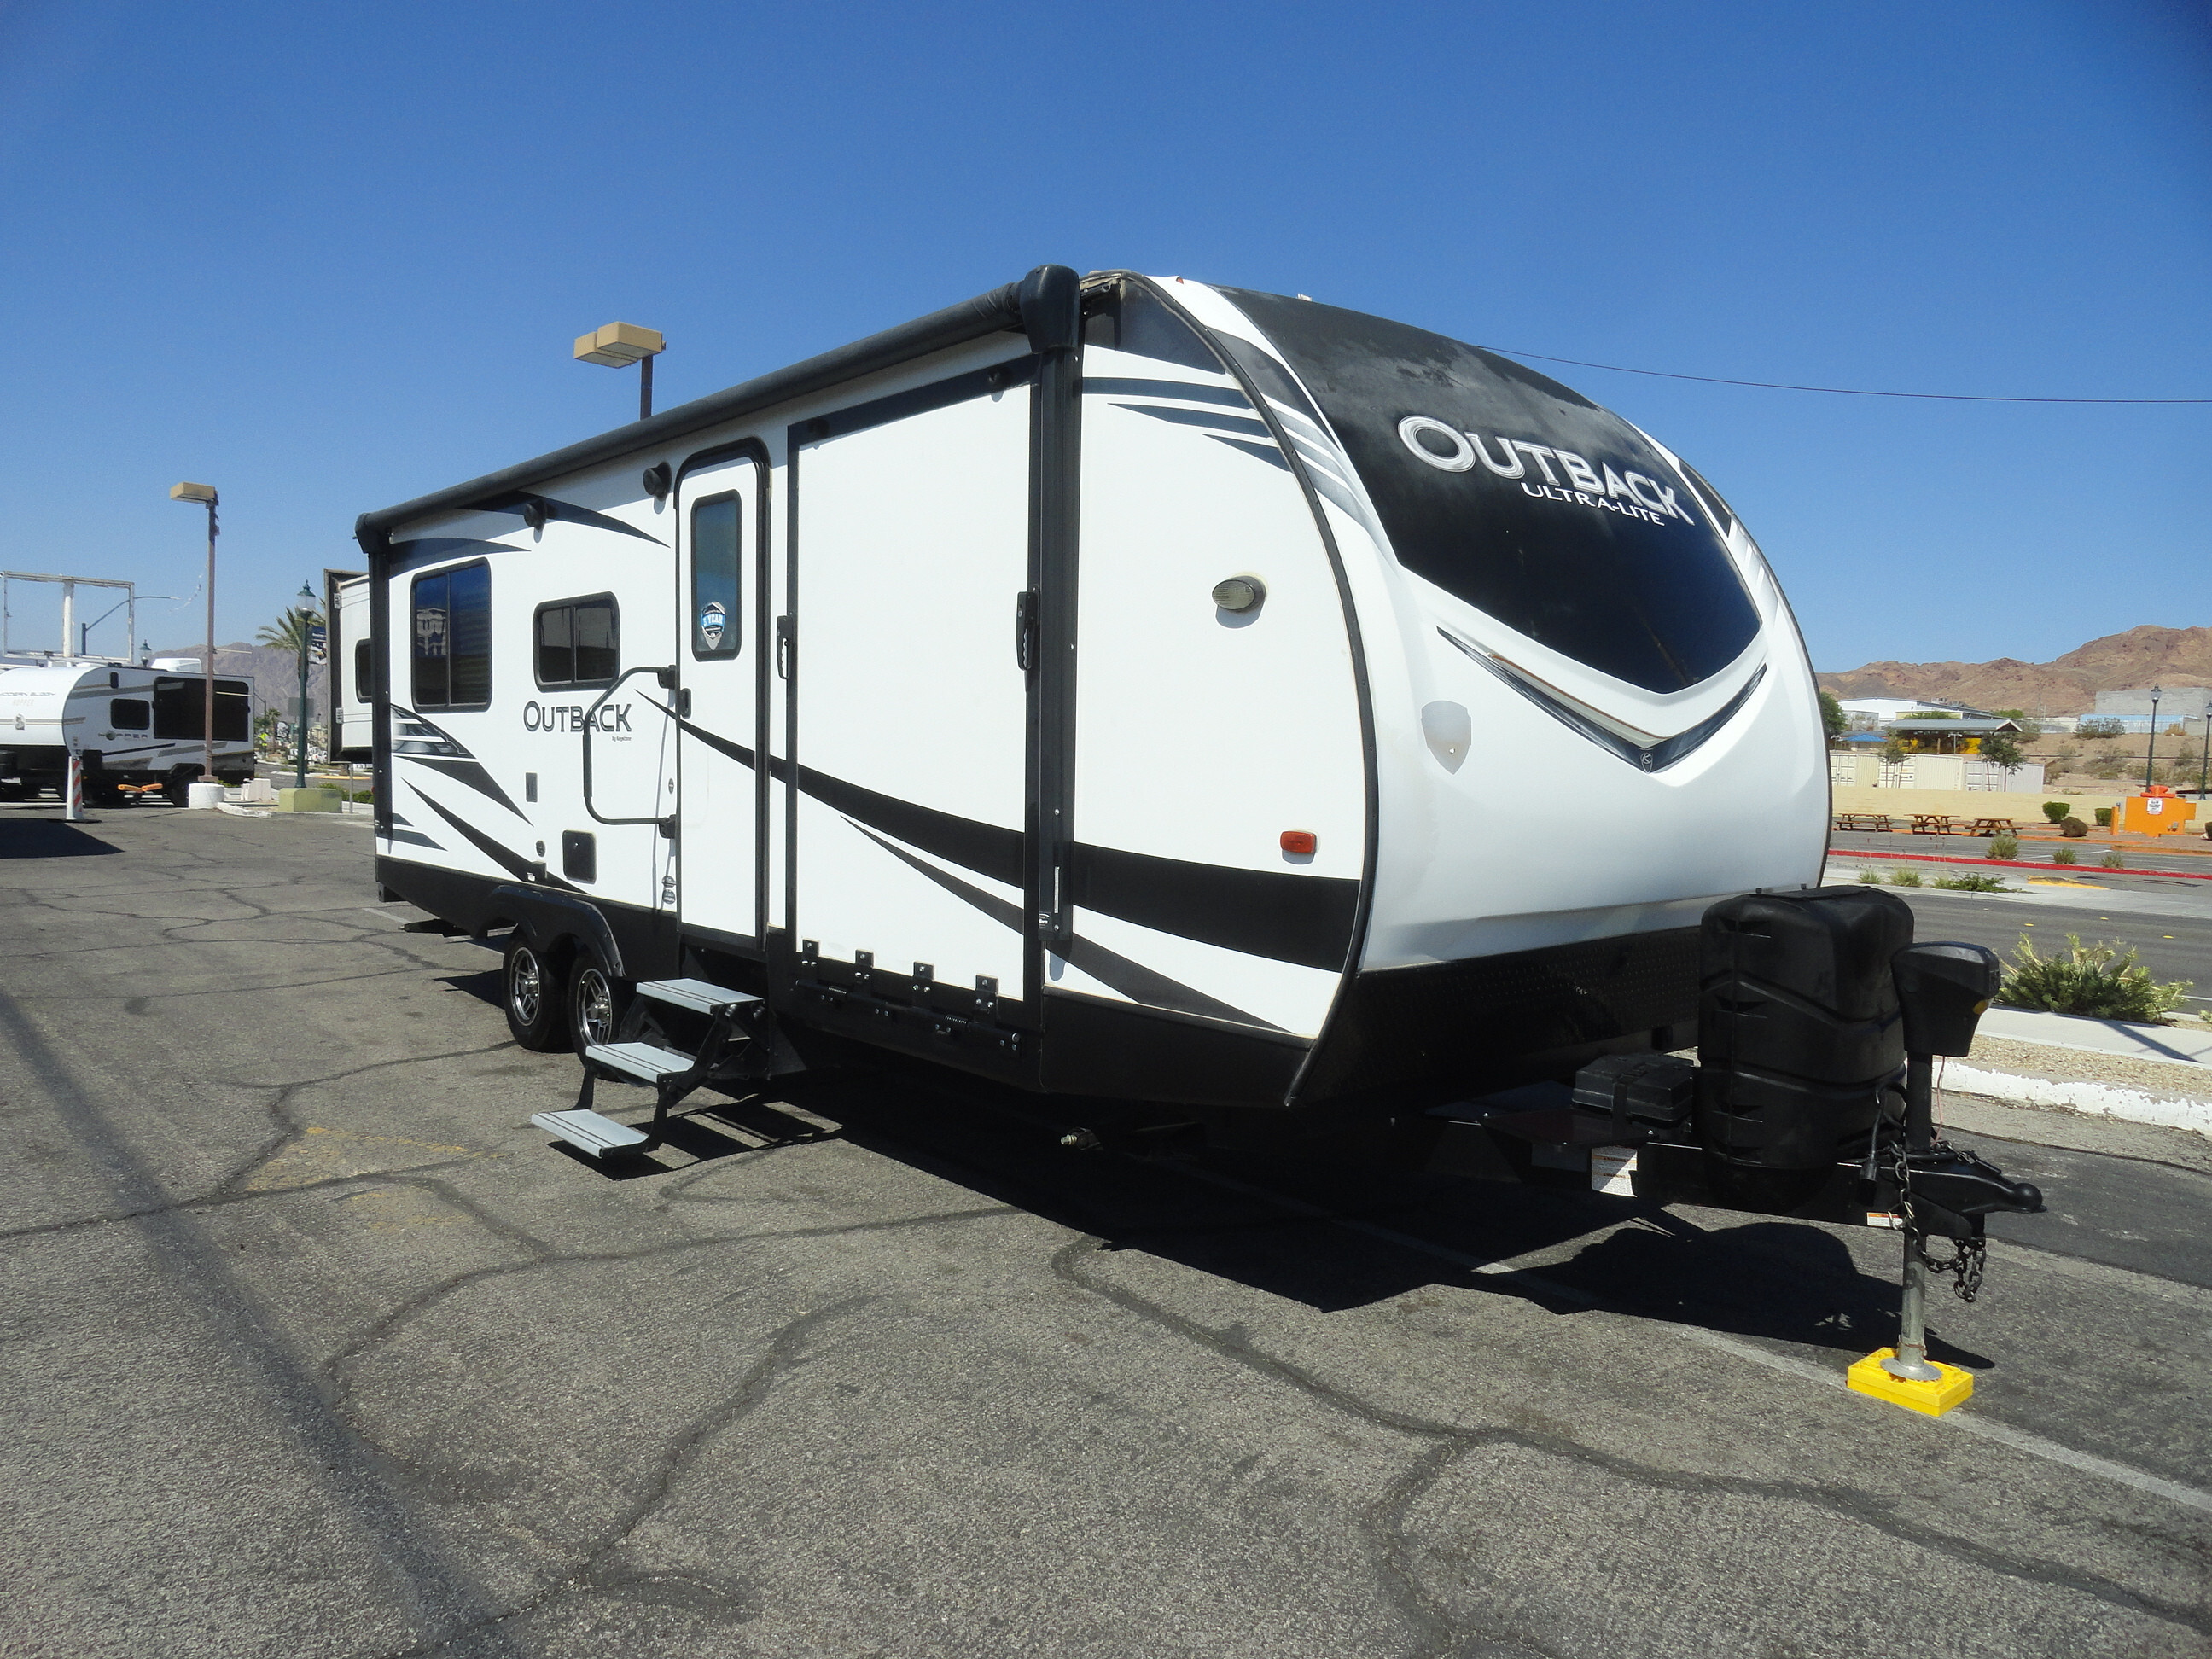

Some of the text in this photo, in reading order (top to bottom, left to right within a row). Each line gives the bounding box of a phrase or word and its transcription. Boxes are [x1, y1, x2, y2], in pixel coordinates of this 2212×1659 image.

[1398, 416, 1695, 526] OUTBACK
[1521, 482, 1665, 526] ULTRA-LITE
[707, 613, 724, 625] YEAR
[523, 701, 632, 732] OUTBACK
